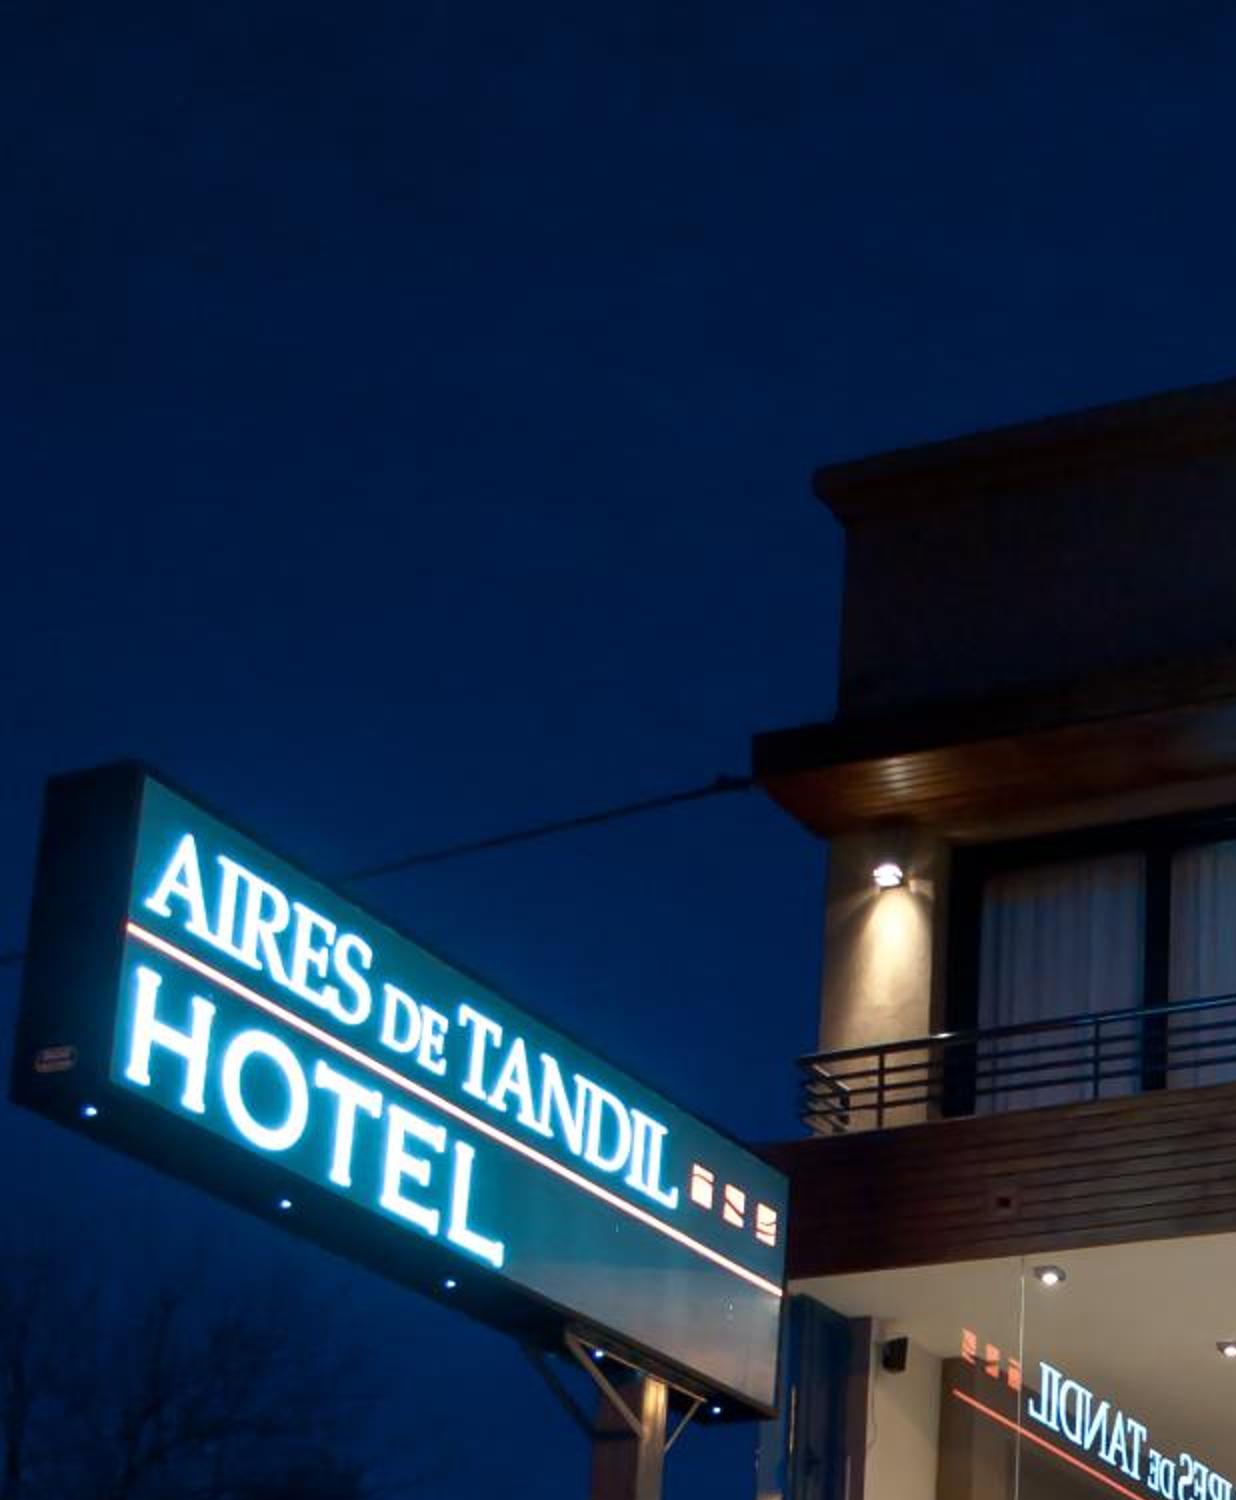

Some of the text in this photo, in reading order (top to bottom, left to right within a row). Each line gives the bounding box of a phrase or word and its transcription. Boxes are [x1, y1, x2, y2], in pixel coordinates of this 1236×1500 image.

[125, 965, 504, 1267] HOTEL
[146, 833, 678, 1209] AIRES DE TANDIL
